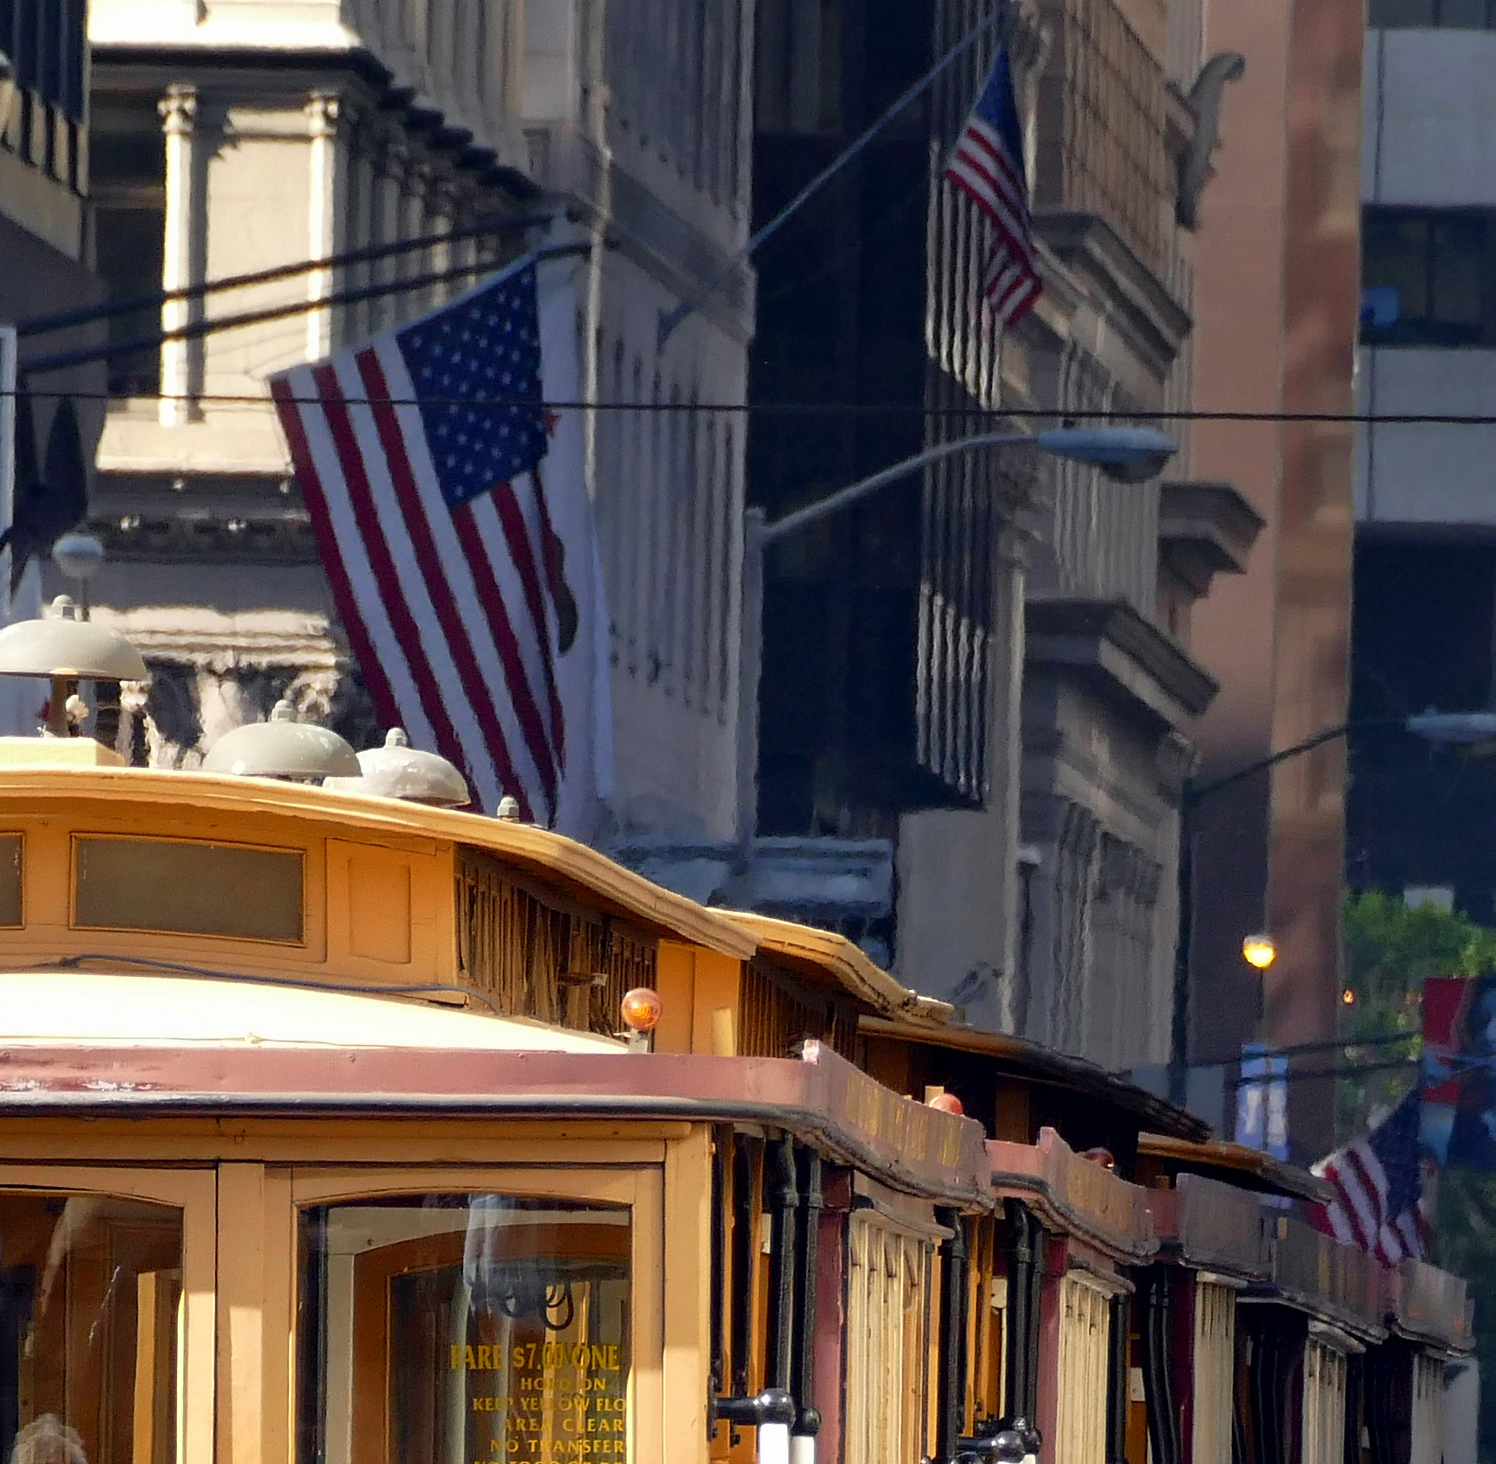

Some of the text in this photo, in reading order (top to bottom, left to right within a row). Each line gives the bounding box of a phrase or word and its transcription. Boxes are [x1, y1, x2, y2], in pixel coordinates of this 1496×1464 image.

[450, 1342, 620, 1371] FARE $7.00 ONE
[520, 1377, 571, 1391] HOLD
[472, 1397, 514, 1412] KEEP
[520, 1397, 589, 1412] YELLOW
[503, 1418, 624, 1432] AREA CLEAR
[490, 1439, 520, 1453] NO
